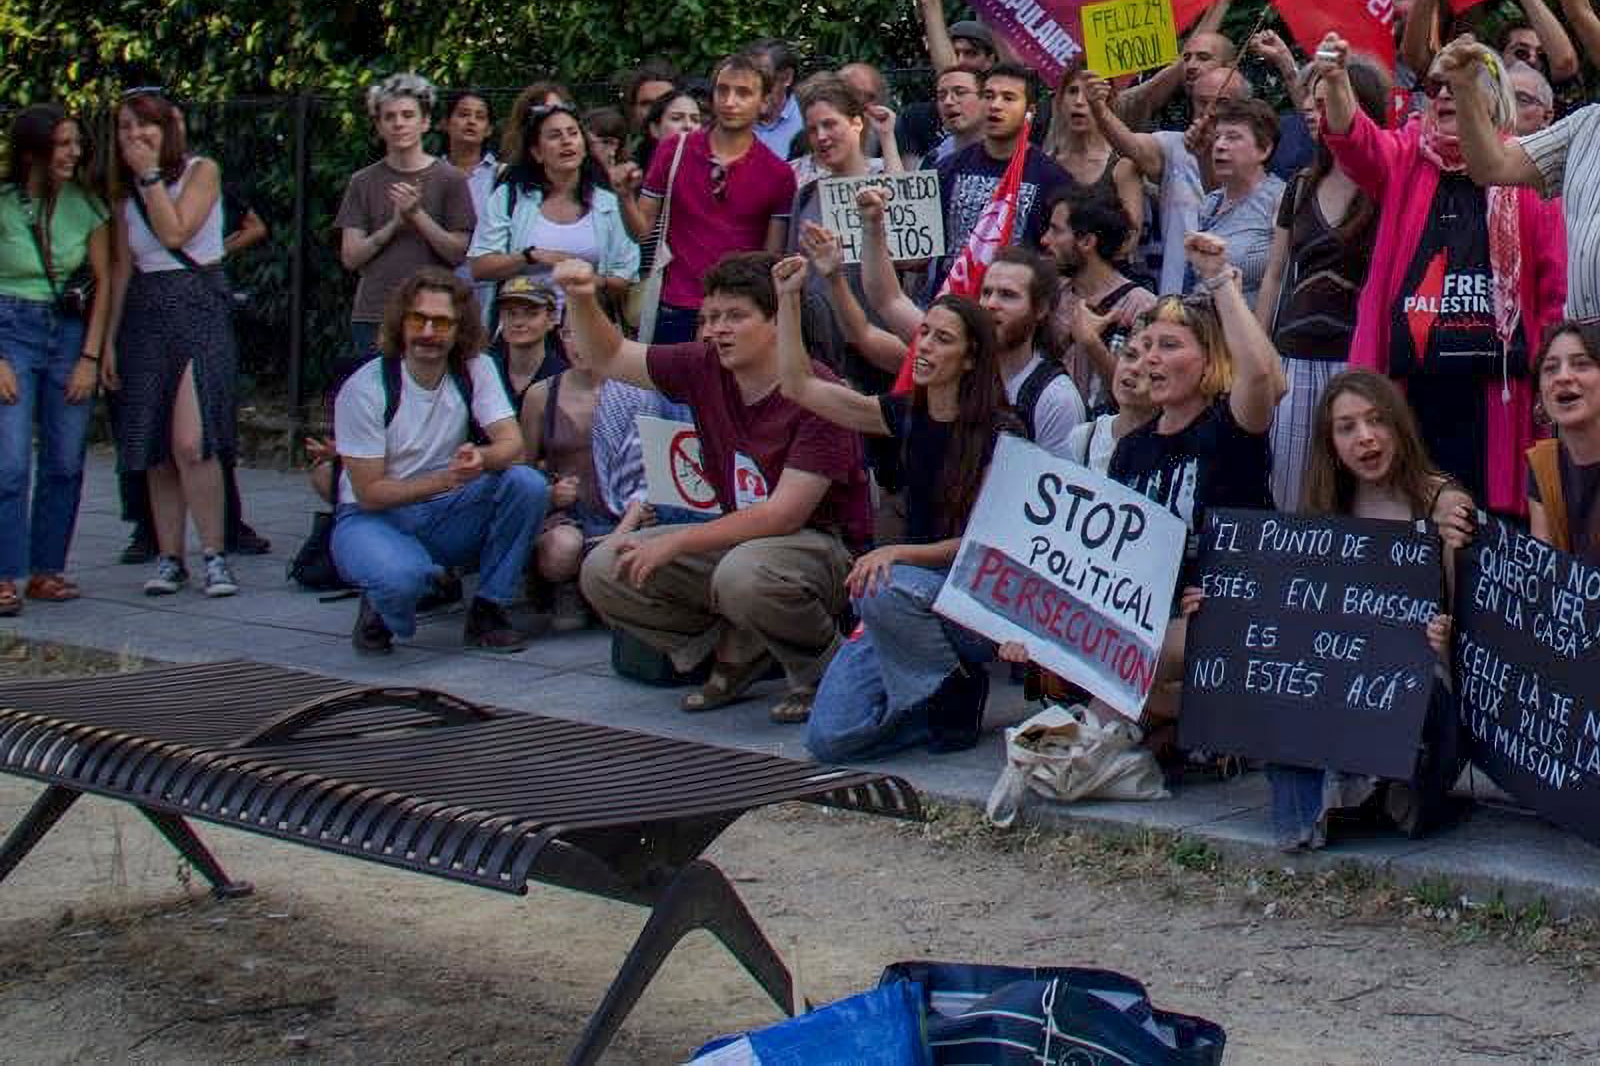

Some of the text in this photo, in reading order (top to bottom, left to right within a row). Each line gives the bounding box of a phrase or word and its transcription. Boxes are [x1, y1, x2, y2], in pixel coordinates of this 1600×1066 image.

[1024, 472, 1146, 562] STOP
[1258, 519, 1333, 554] PUNTO
[1341, 534, 1371, 559] DE
[1391, 540, 1433, 566] QUE
[1287, 578, 1328, 611] EN
[1475, 576, 1500, 612] EN
[1505, 594, 1523, 630] LA
[1552, 584, 1586, 634] VER
[1245, 624, 1367, 661] ES QUE
[1194, 657, 1225, 688] NO
[1472, 709, 1487, 742] LA
[1550, 693, 1574, 726] JE
[1520, 709, 1567, 754] PLUS
[1575, 740, 1600, 775] LA
